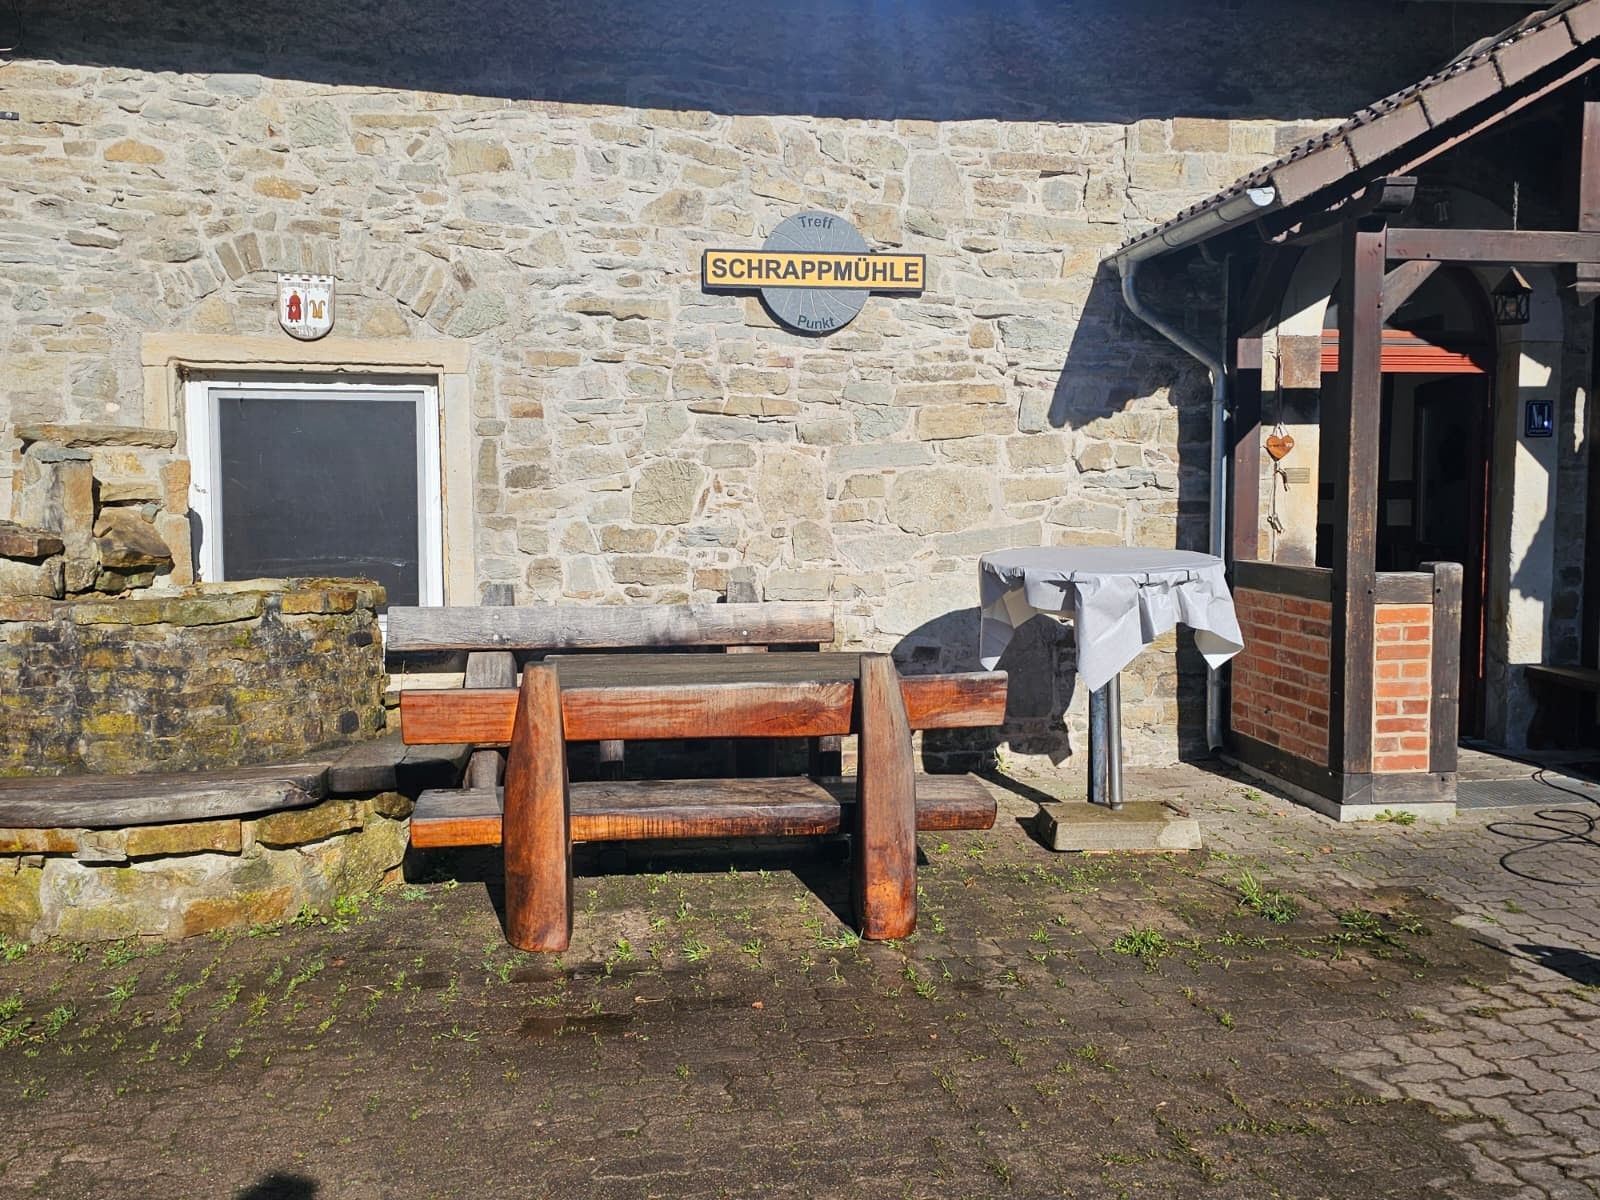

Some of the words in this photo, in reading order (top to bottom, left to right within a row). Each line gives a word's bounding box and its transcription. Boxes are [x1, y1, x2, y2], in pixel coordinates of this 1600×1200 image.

[798, 216, 834, 230] Treff
[711, 257, 920, 282] SCHRAPPMÜHLE
[797, 314, 836, 330] Punkt
